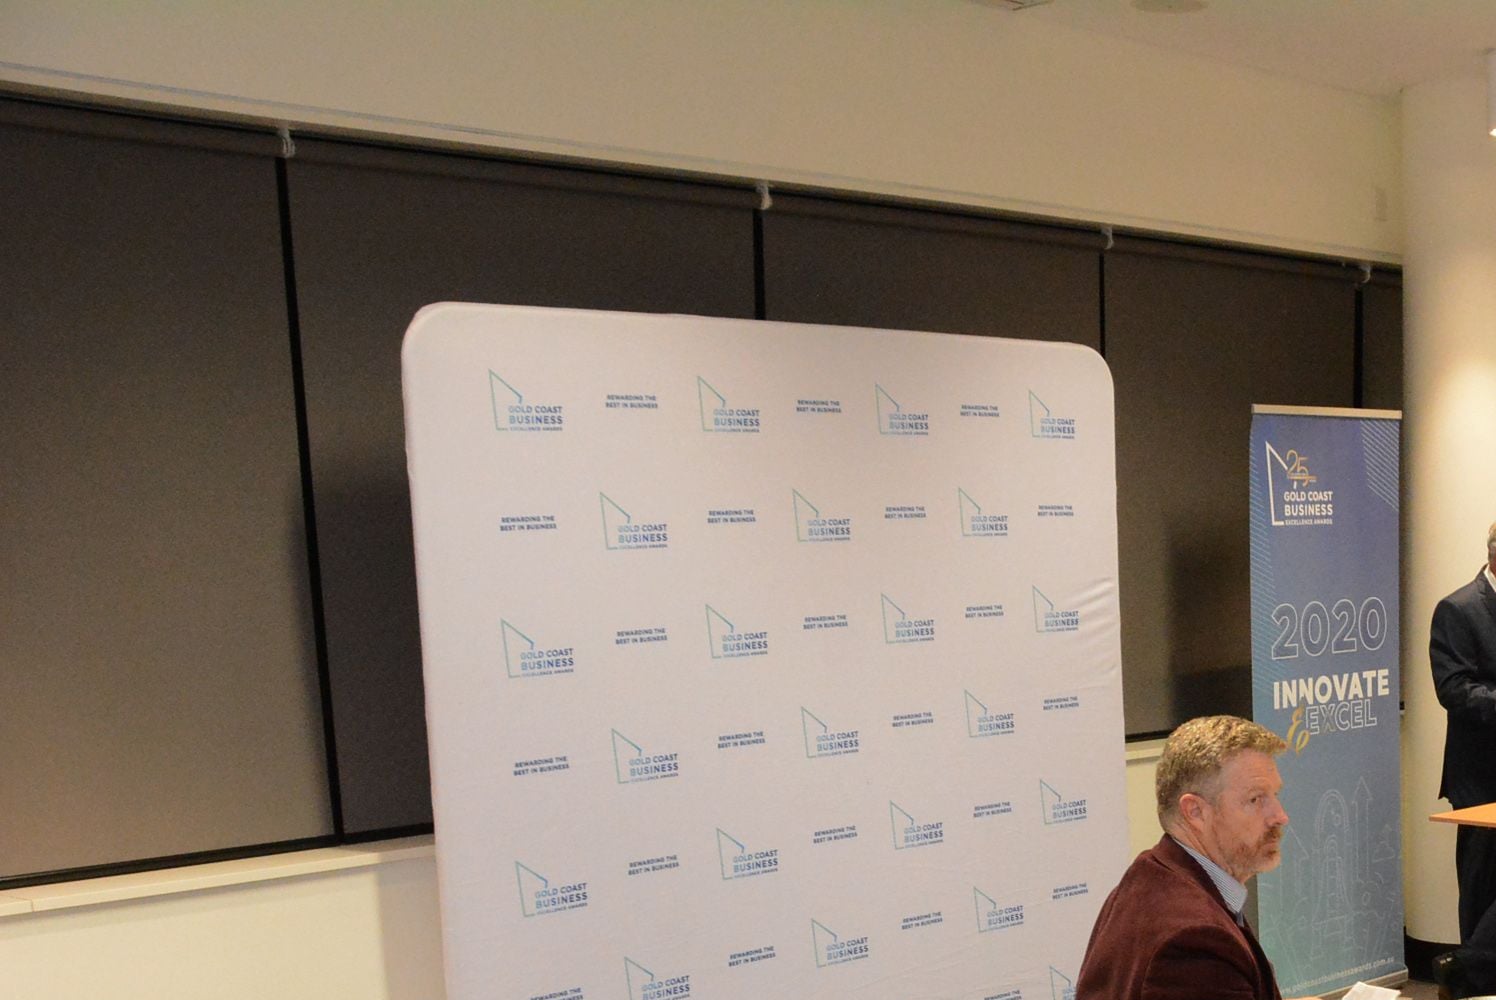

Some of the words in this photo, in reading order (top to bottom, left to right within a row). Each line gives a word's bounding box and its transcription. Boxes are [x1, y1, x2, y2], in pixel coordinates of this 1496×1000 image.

[508, 405, 532, 413] GOLD
[508, 415, 563, 424] BUSINESS
[713, 418, 760, 426] BUSINESS
[889, 421, 928, 430] BUSINESS
[1284, 491, 1306, 502] GOLD
[1308, 491, 1333, 501] COAST
[1284, 504, 1333, 516] BUSINESS
[808, 527, 850, 536] BUSINESS
[971, 523, 1007, 531] BUSINESS
[618, 533, 667, 543] BUSINESS
[1271, 596, 1387, 660] 2020
[639, 635, 667, 643] BUSINESS
[721, 634, 742, 642] GOLD
[744, 632, 767, 640] COAST
[722, 640, 768, 652] BUSINESS
[519, 650, 544, 659] GOLD
[546, 648, 573, 657] COAST
[520, 657, 574, 670] BUSINESS
[1273, 669, 1389, 710] INNOVATE
[1306, 699, 1377, 735] EXCEL
[816, 733, 835, 742] GOLD
[837, 731, 858, 739] COAST
[817, 739, 858, 752] BUSINESS
[629, 756, 651, 766] GOLD
[653, 753, 678, 763] COAST
[539, 763, 569, 773] BUSINESS
[629, 762, 678, 776] BUSINESS
[904, 825, 921, 834] GOLD
[923, 822, 942, 831] COAST
[904, 829, 943, 843] BUSINESS
[732, 853, 753, 863] GOLD
[754, 849, 777, 859] COAST
[651, 861, 679, 872] BUSINESS
[733, 857, 778, 873] BUSINESS
[534, 887, 558, 898] GOLD
[560, 882, 587, 894] COAST
[535, 891, 587, 909] BUSINESS
[826, 941, 845, 951] GOLD
[847, 936, 868, 947] COAST
[827, 944, 868, 961] BUSINESS
[641, 980, 663, 992] GOLD
[665, 975, 690, 986] COAST
